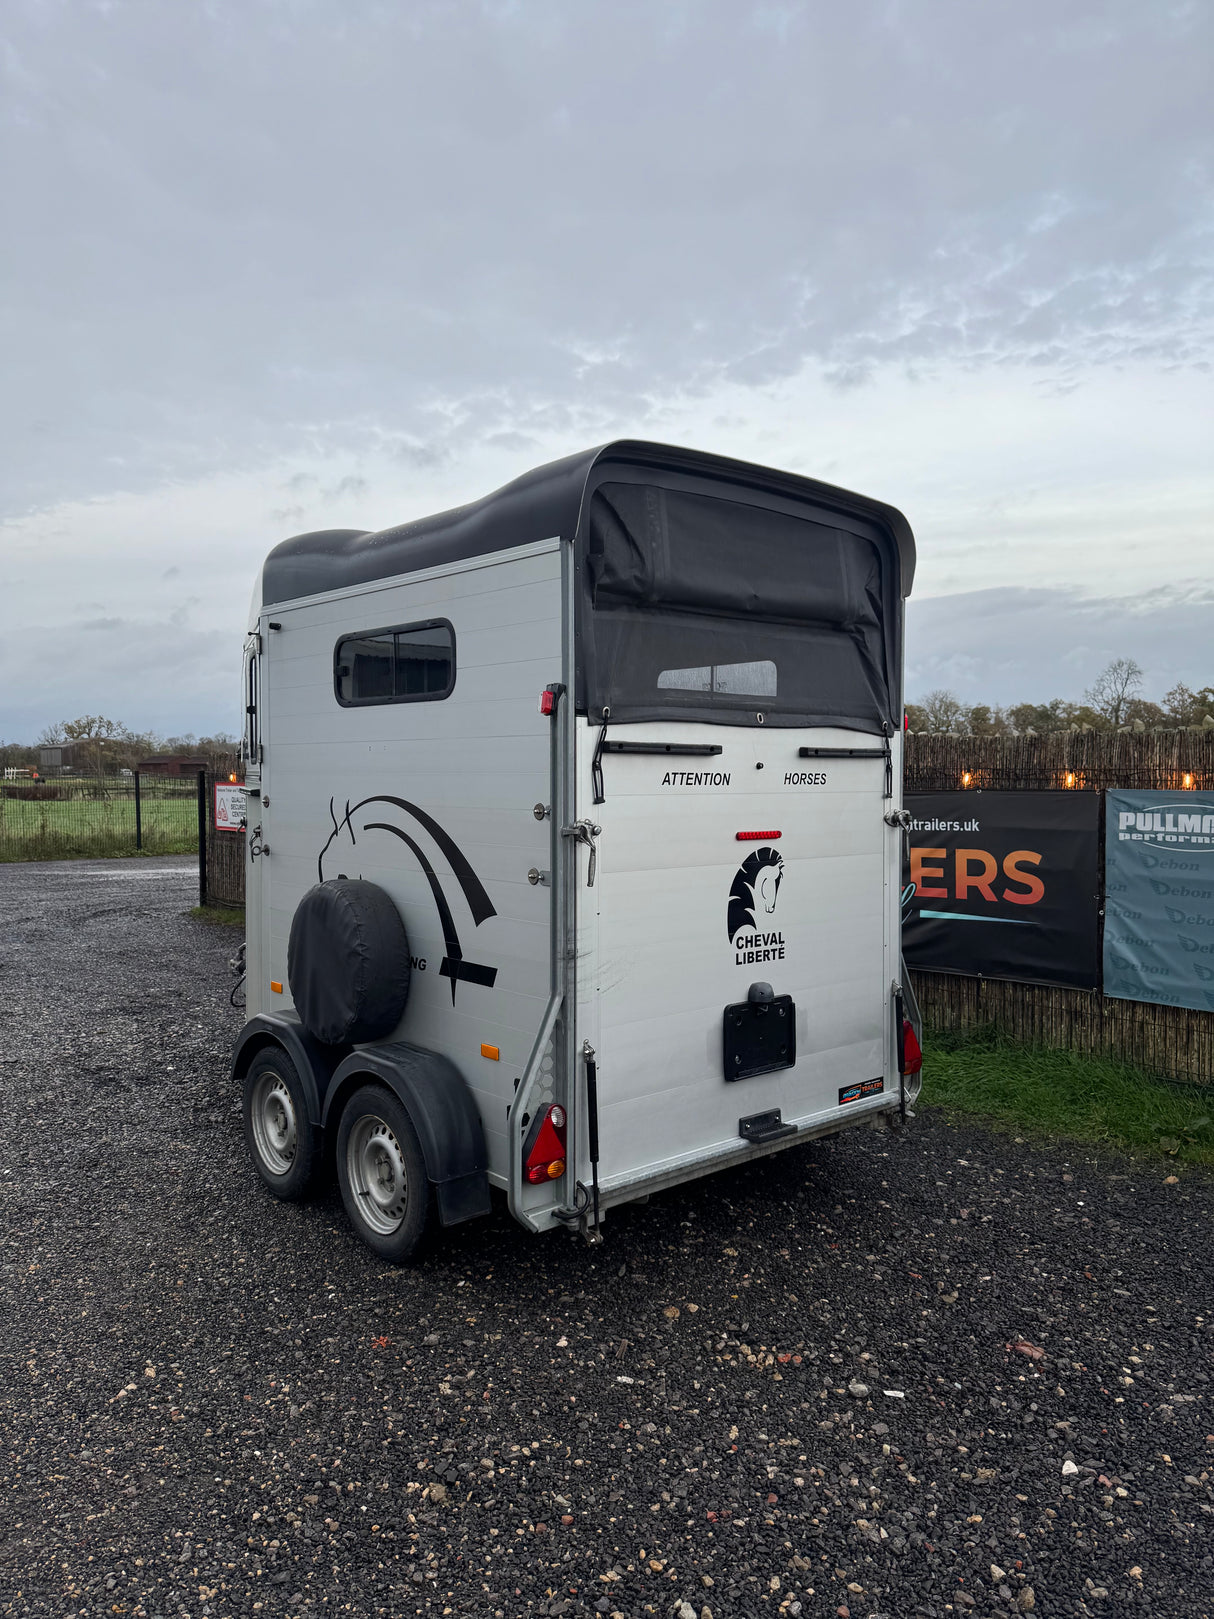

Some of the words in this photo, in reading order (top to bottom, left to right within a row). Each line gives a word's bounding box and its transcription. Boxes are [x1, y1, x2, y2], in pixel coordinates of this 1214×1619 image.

[662, 772, 731, 786] ATTENTION
[784, 772, 827, 785] HORSES
[1119, 832, 1214, 843] perform
[910, 847, 1045, 904] ERS
[736, 931, 785, 949] CHEVAL
